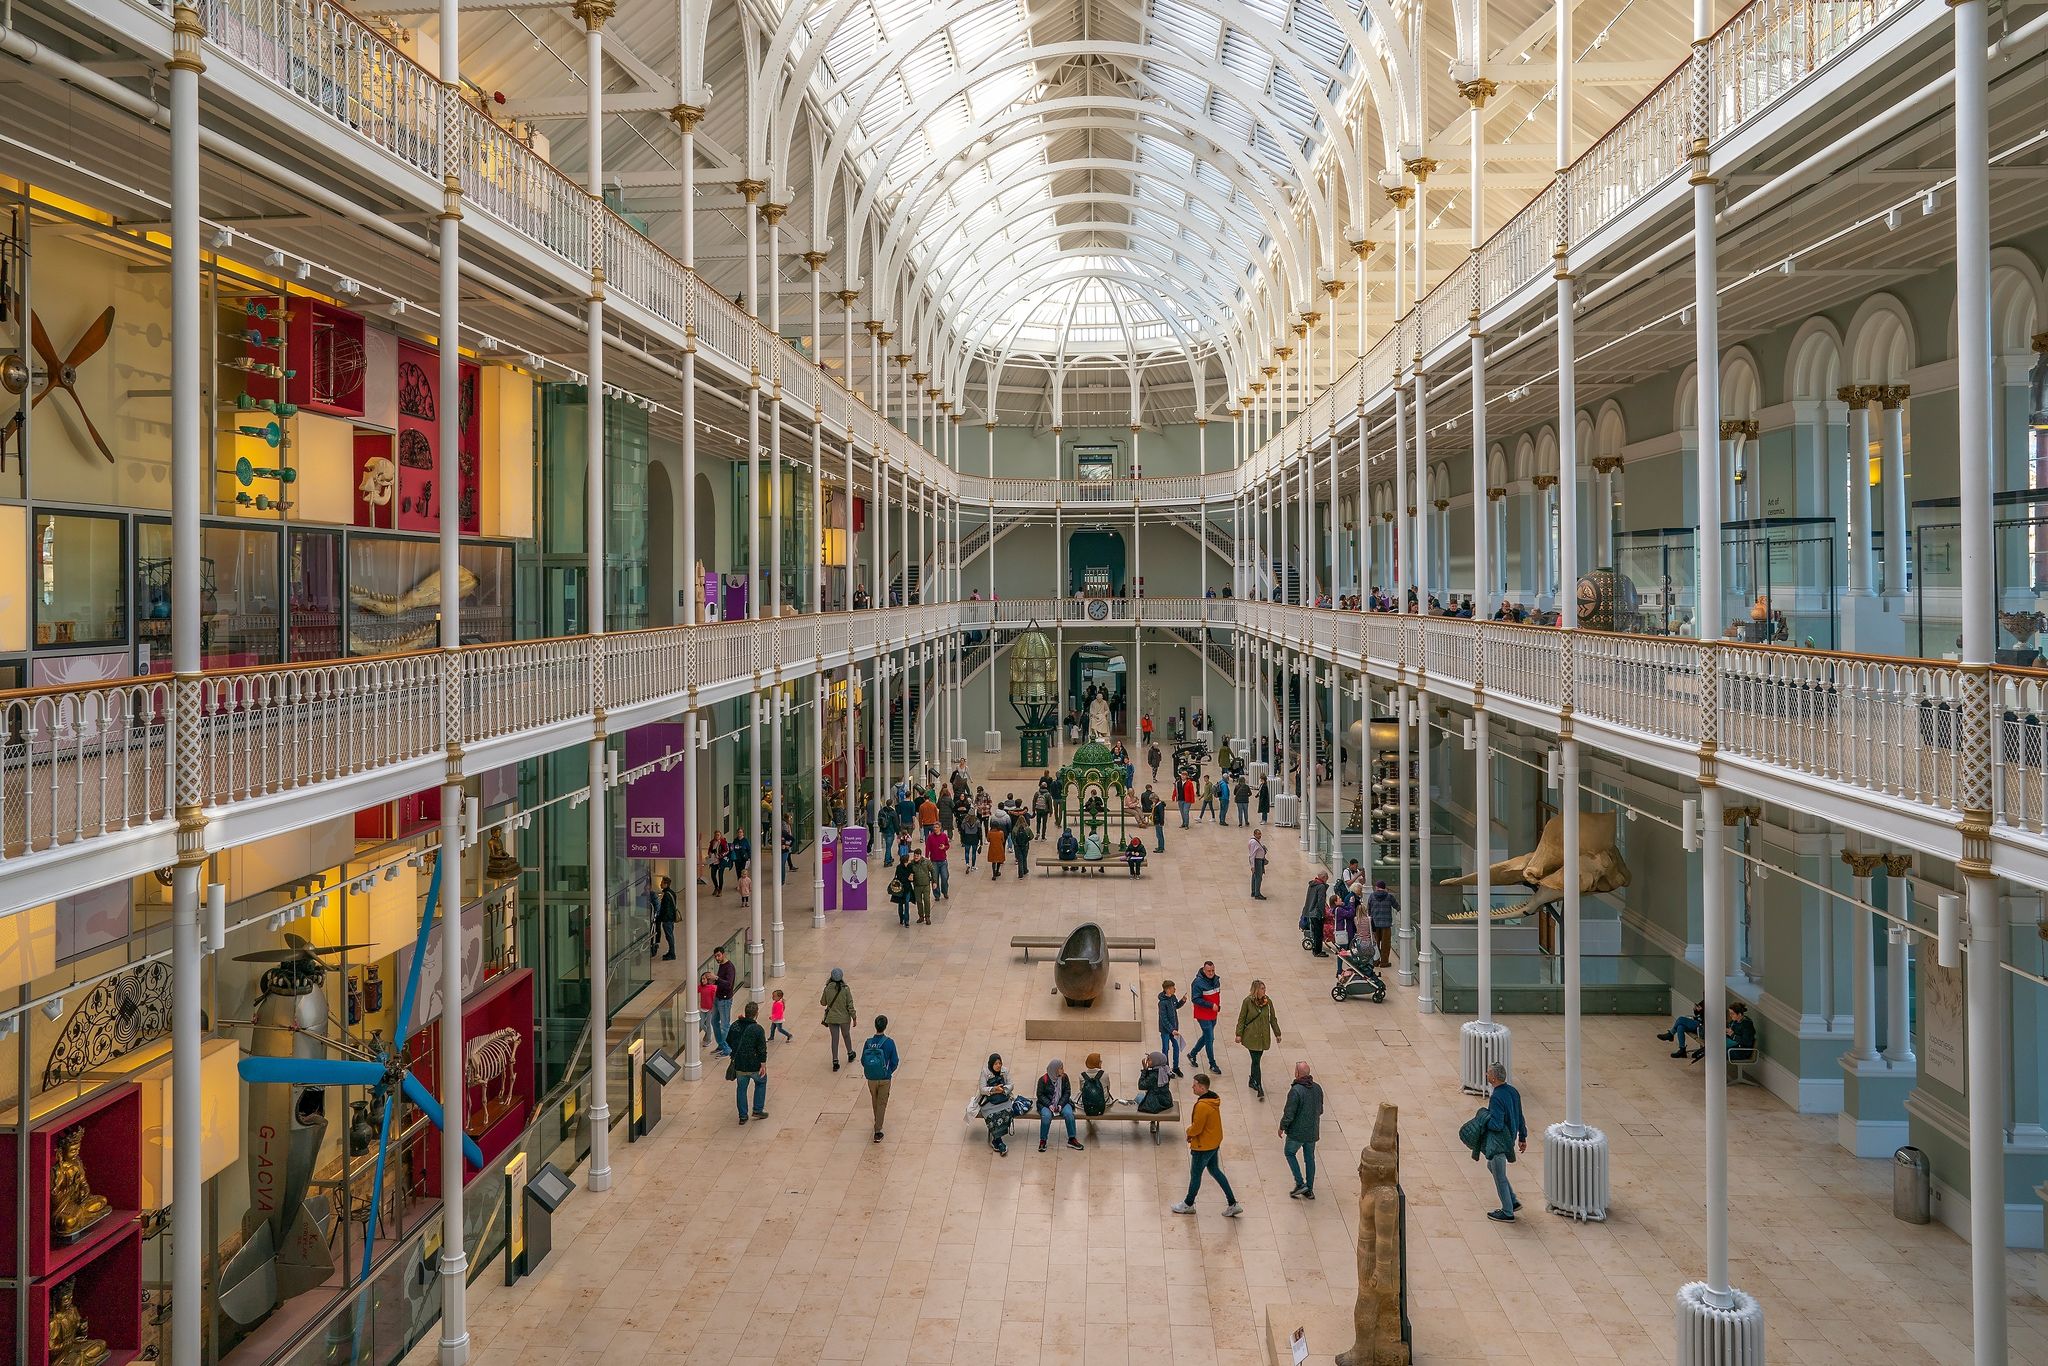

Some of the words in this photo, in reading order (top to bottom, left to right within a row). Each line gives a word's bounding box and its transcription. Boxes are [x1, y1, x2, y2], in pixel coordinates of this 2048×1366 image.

[634, 821, 661, 834] Exit
[631, 843, 648, 852] Shop
[257, 1125, 276, 1211] G-ACVA
